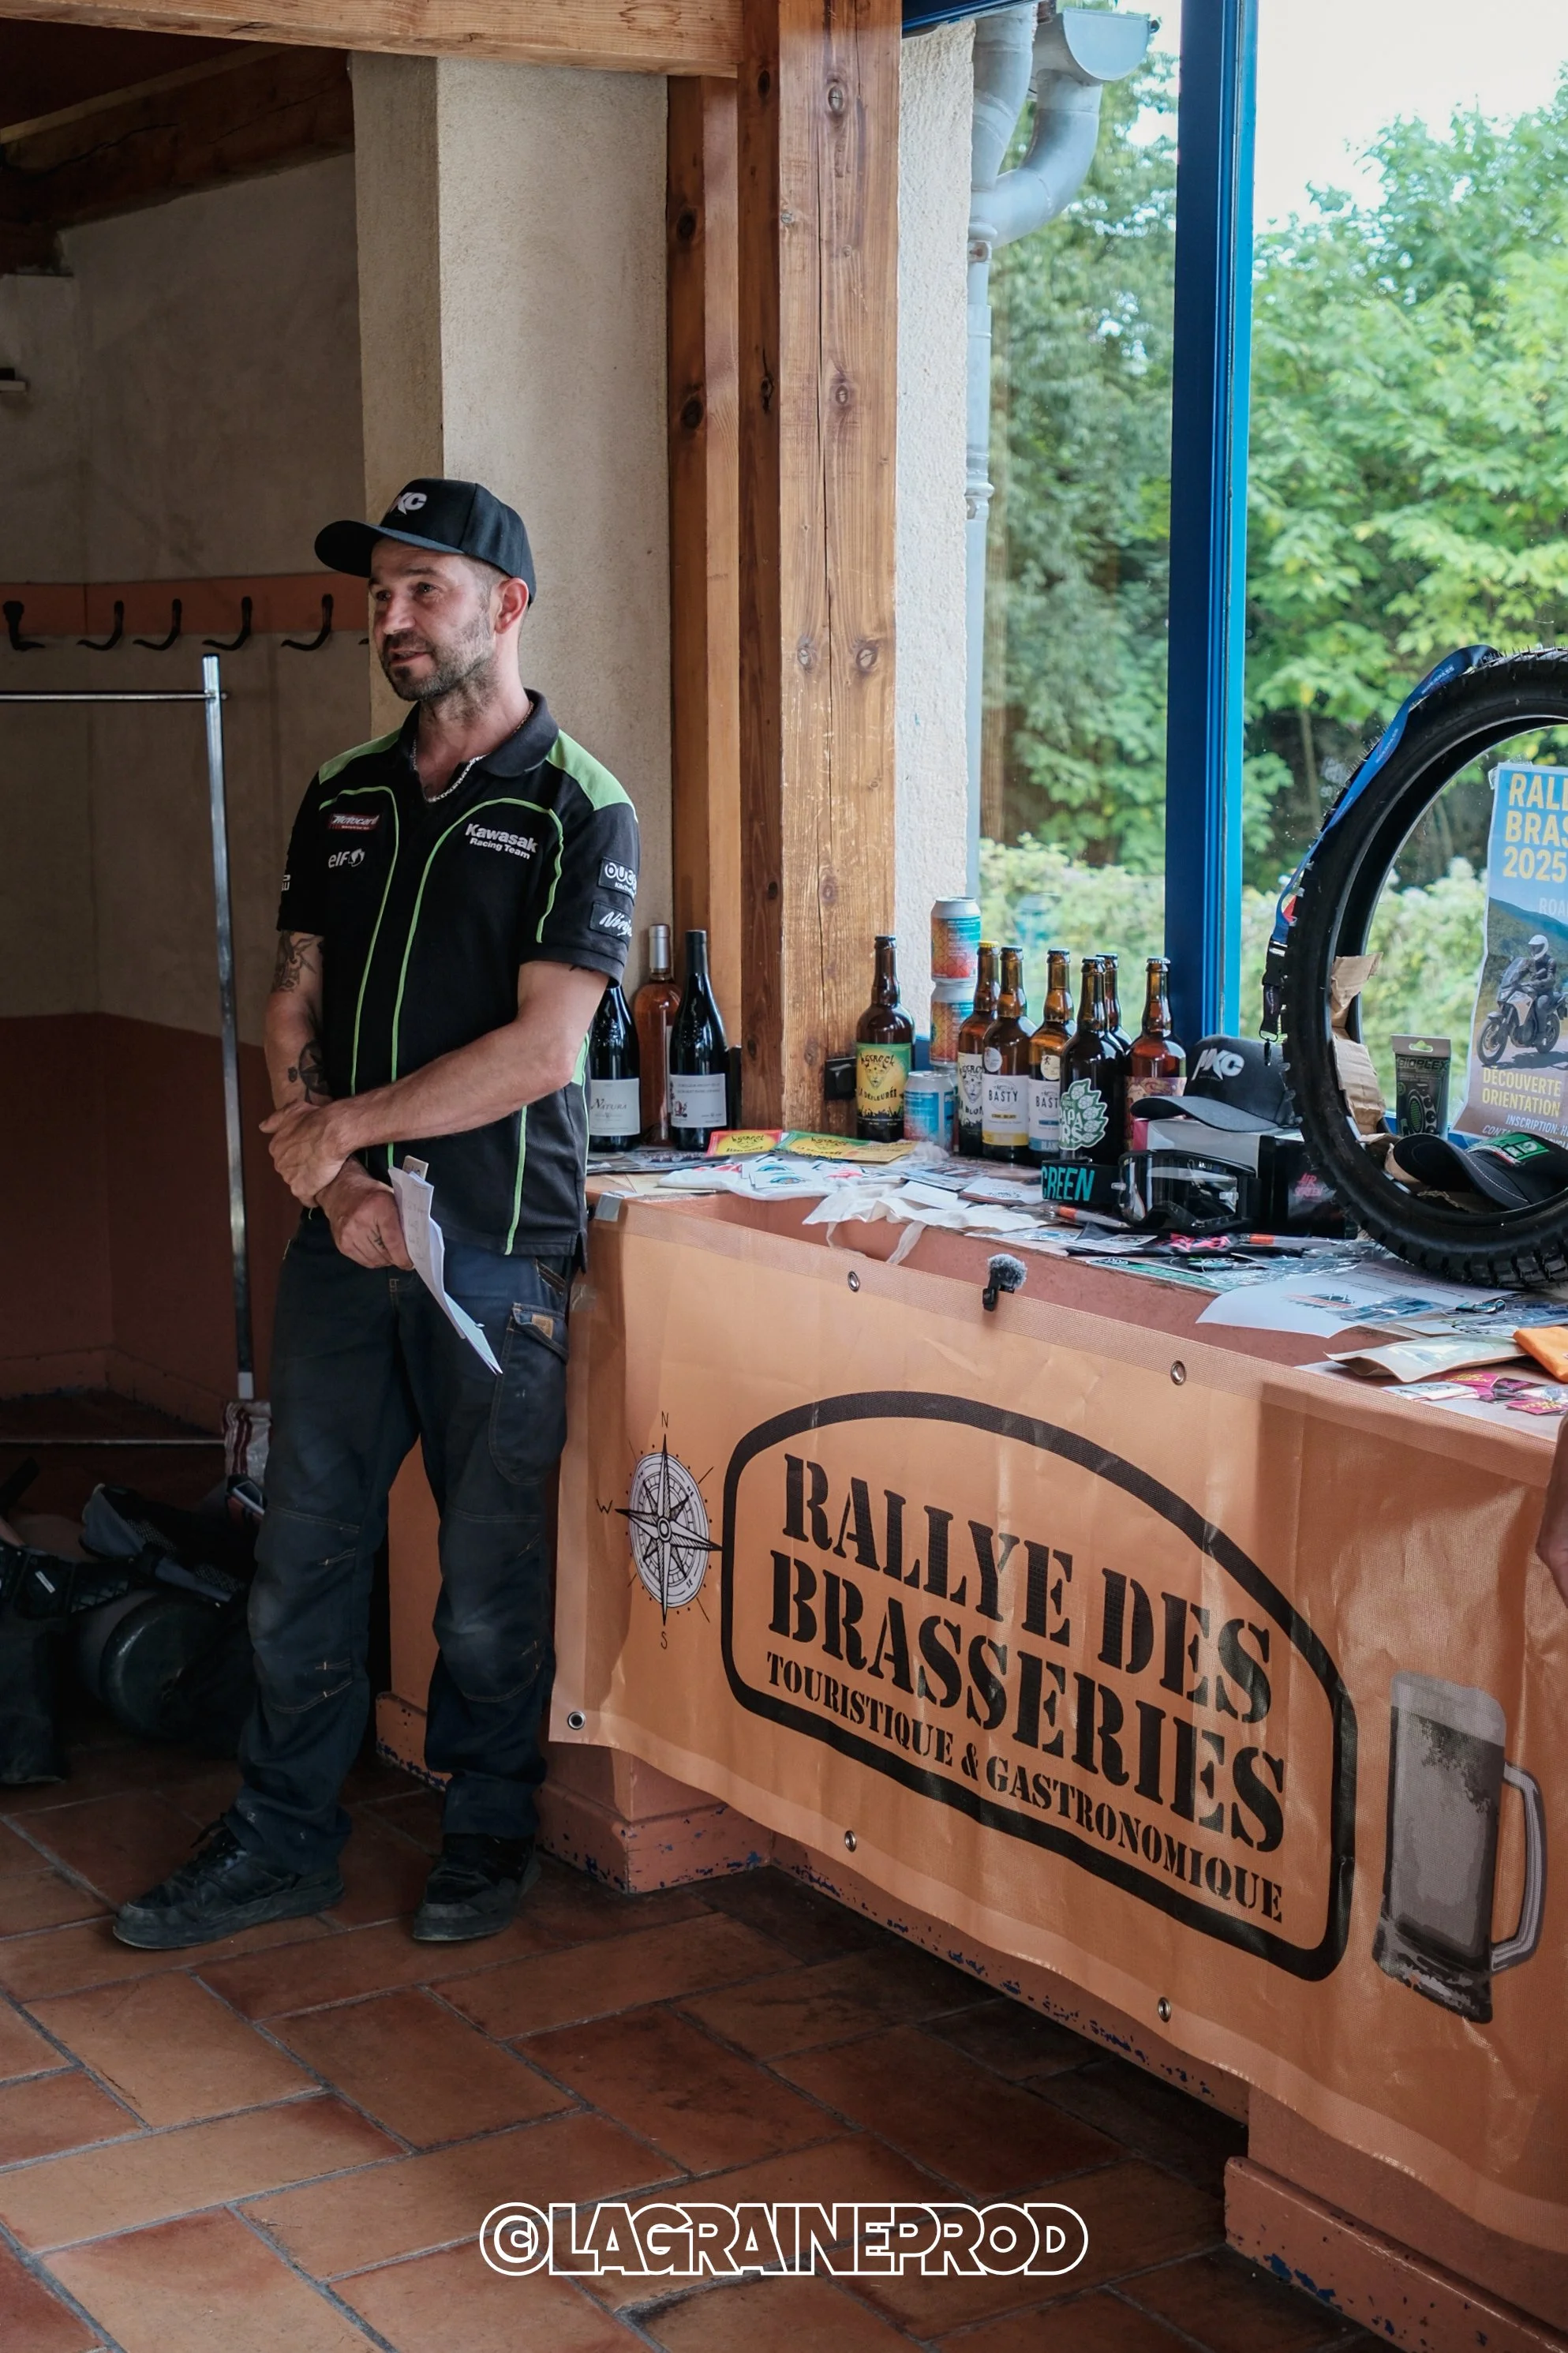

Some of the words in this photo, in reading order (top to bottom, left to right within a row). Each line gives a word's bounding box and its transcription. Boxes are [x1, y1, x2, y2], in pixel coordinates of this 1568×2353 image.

[465, 823, 538, 853] Kawasak
[470, 837, 503, 852] Racing
[504, 844, 530, 860] Team
[327, 851, 351, 868] elf
[1503, 845, 1566, 883] 2025
[1539, 897, 1568, 918] ROA
[1483, 1065, 1562, 1097] DÉCOUVERTE
[988, 1089, 1019, 1102] BASTY
[1035, 1096, 1059, 1109] BAST
[1482, 1088, 1561, 1118] ORIENTATION
[1505, 1114, 1559, 1135] INSCRIPTION:
[661, 1411, 669, 1428] N
[596, 1498, 613, 1515] W
[783, 1453, 1073, 1647] RALLYE
[1098, 1567, 1272, 1724] DES
[661, 1631, 668, 1650] S
[768, 1549, 1285, 1853] BRASSERIES
[766, 1651, 953, 1767] TOURISTIQUE
[960, 1741, 979, 1781] &
[986, 1755, 1283, 1924] GASTRONOMIQUE
